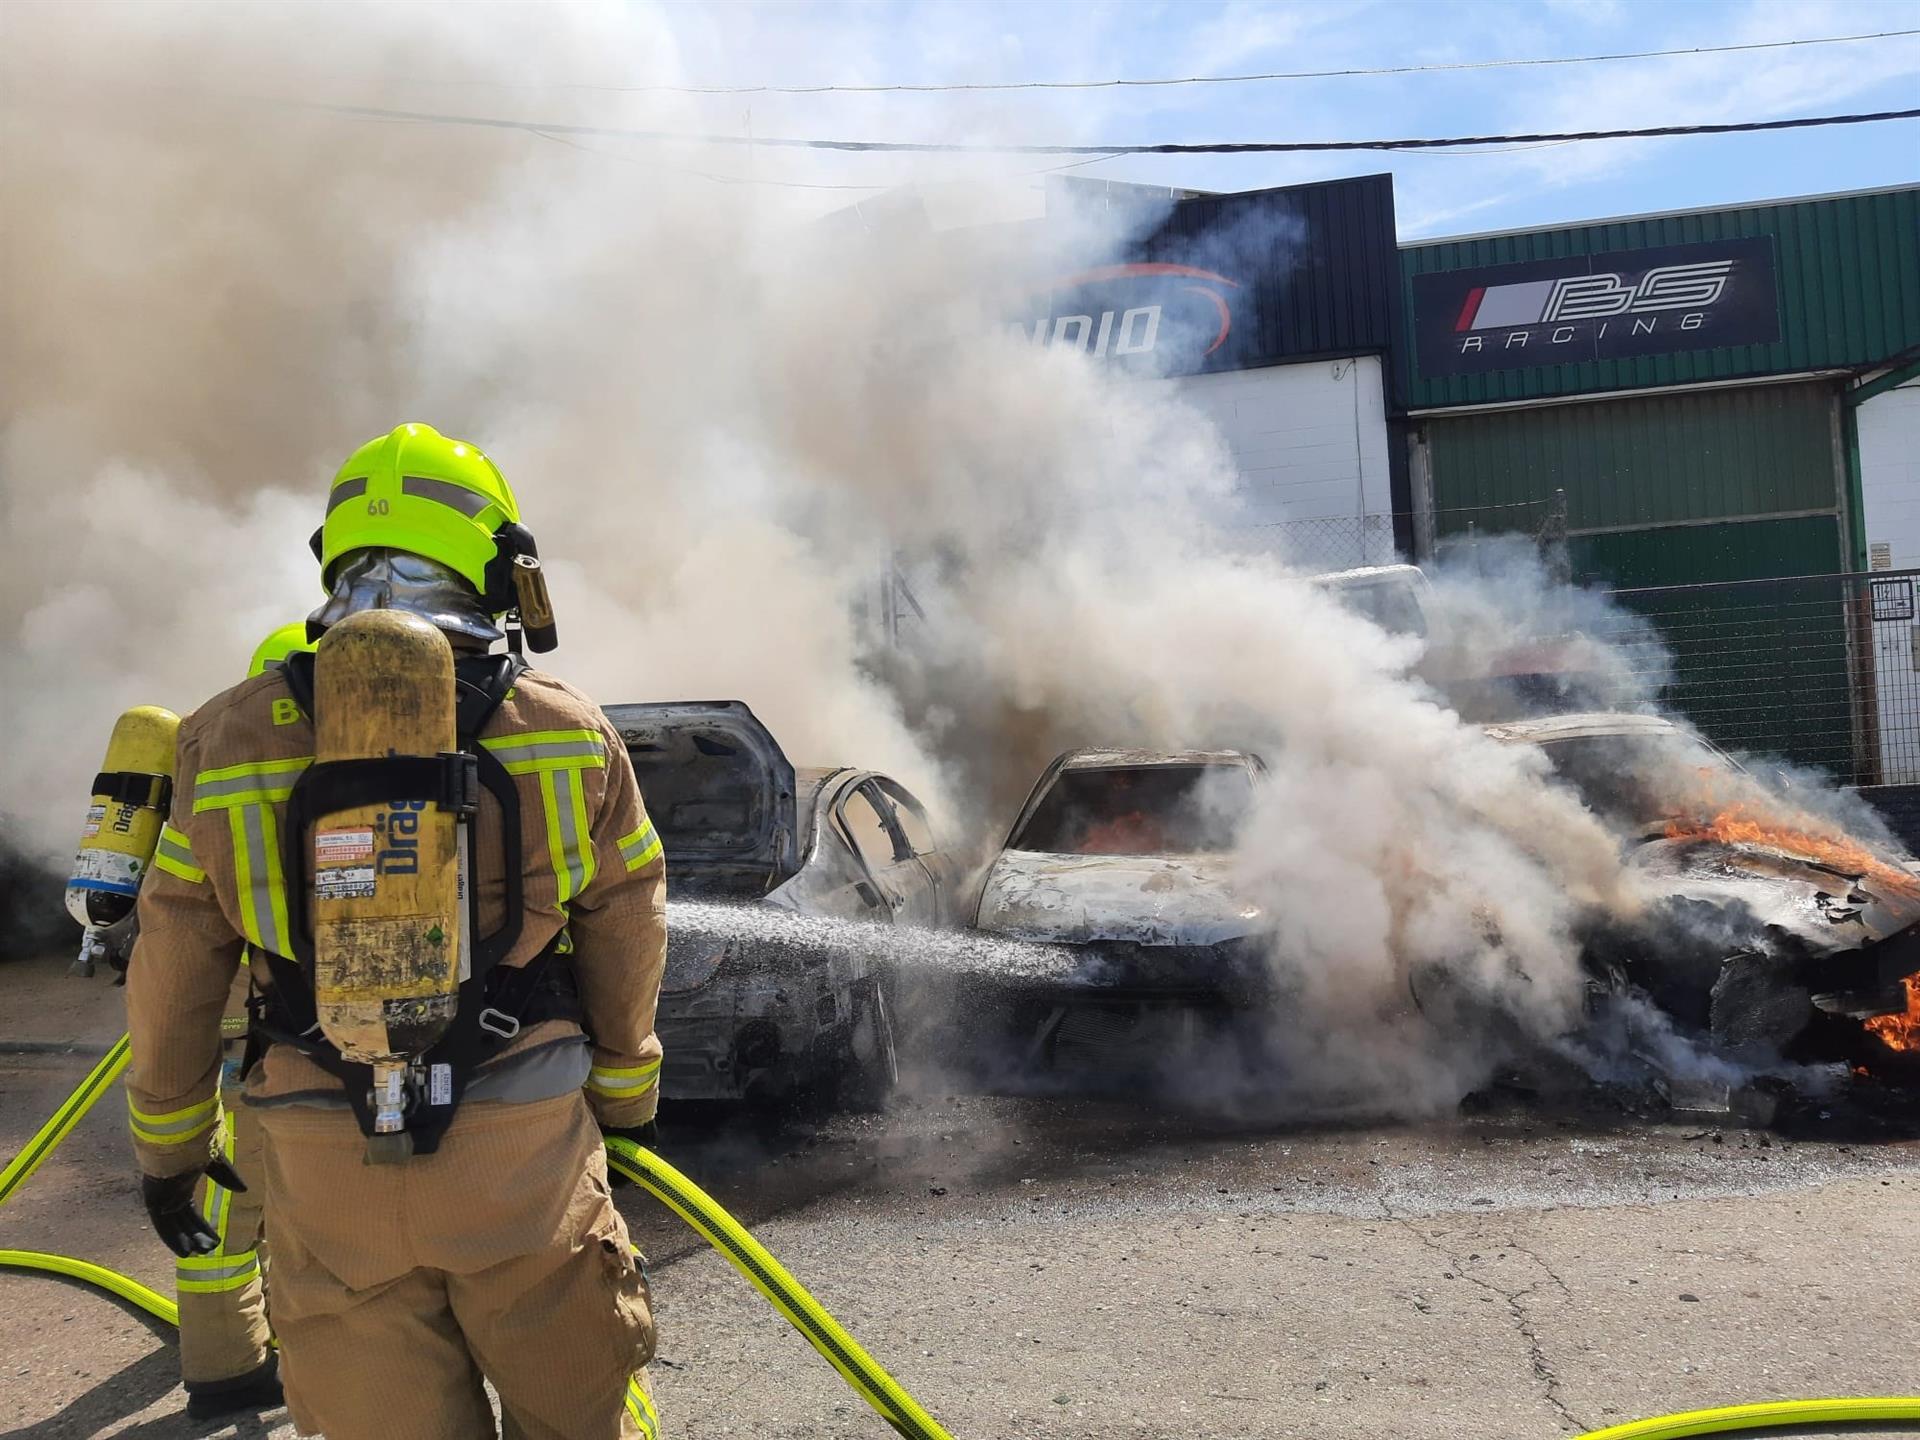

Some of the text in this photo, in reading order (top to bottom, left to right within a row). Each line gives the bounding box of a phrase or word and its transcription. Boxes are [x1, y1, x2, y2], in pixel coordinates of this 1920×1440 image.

[1003, 304, 1162, 358] NDIO
[1461, 312, 1704, 354] RACING
[367, 499, 389, 516] 60
